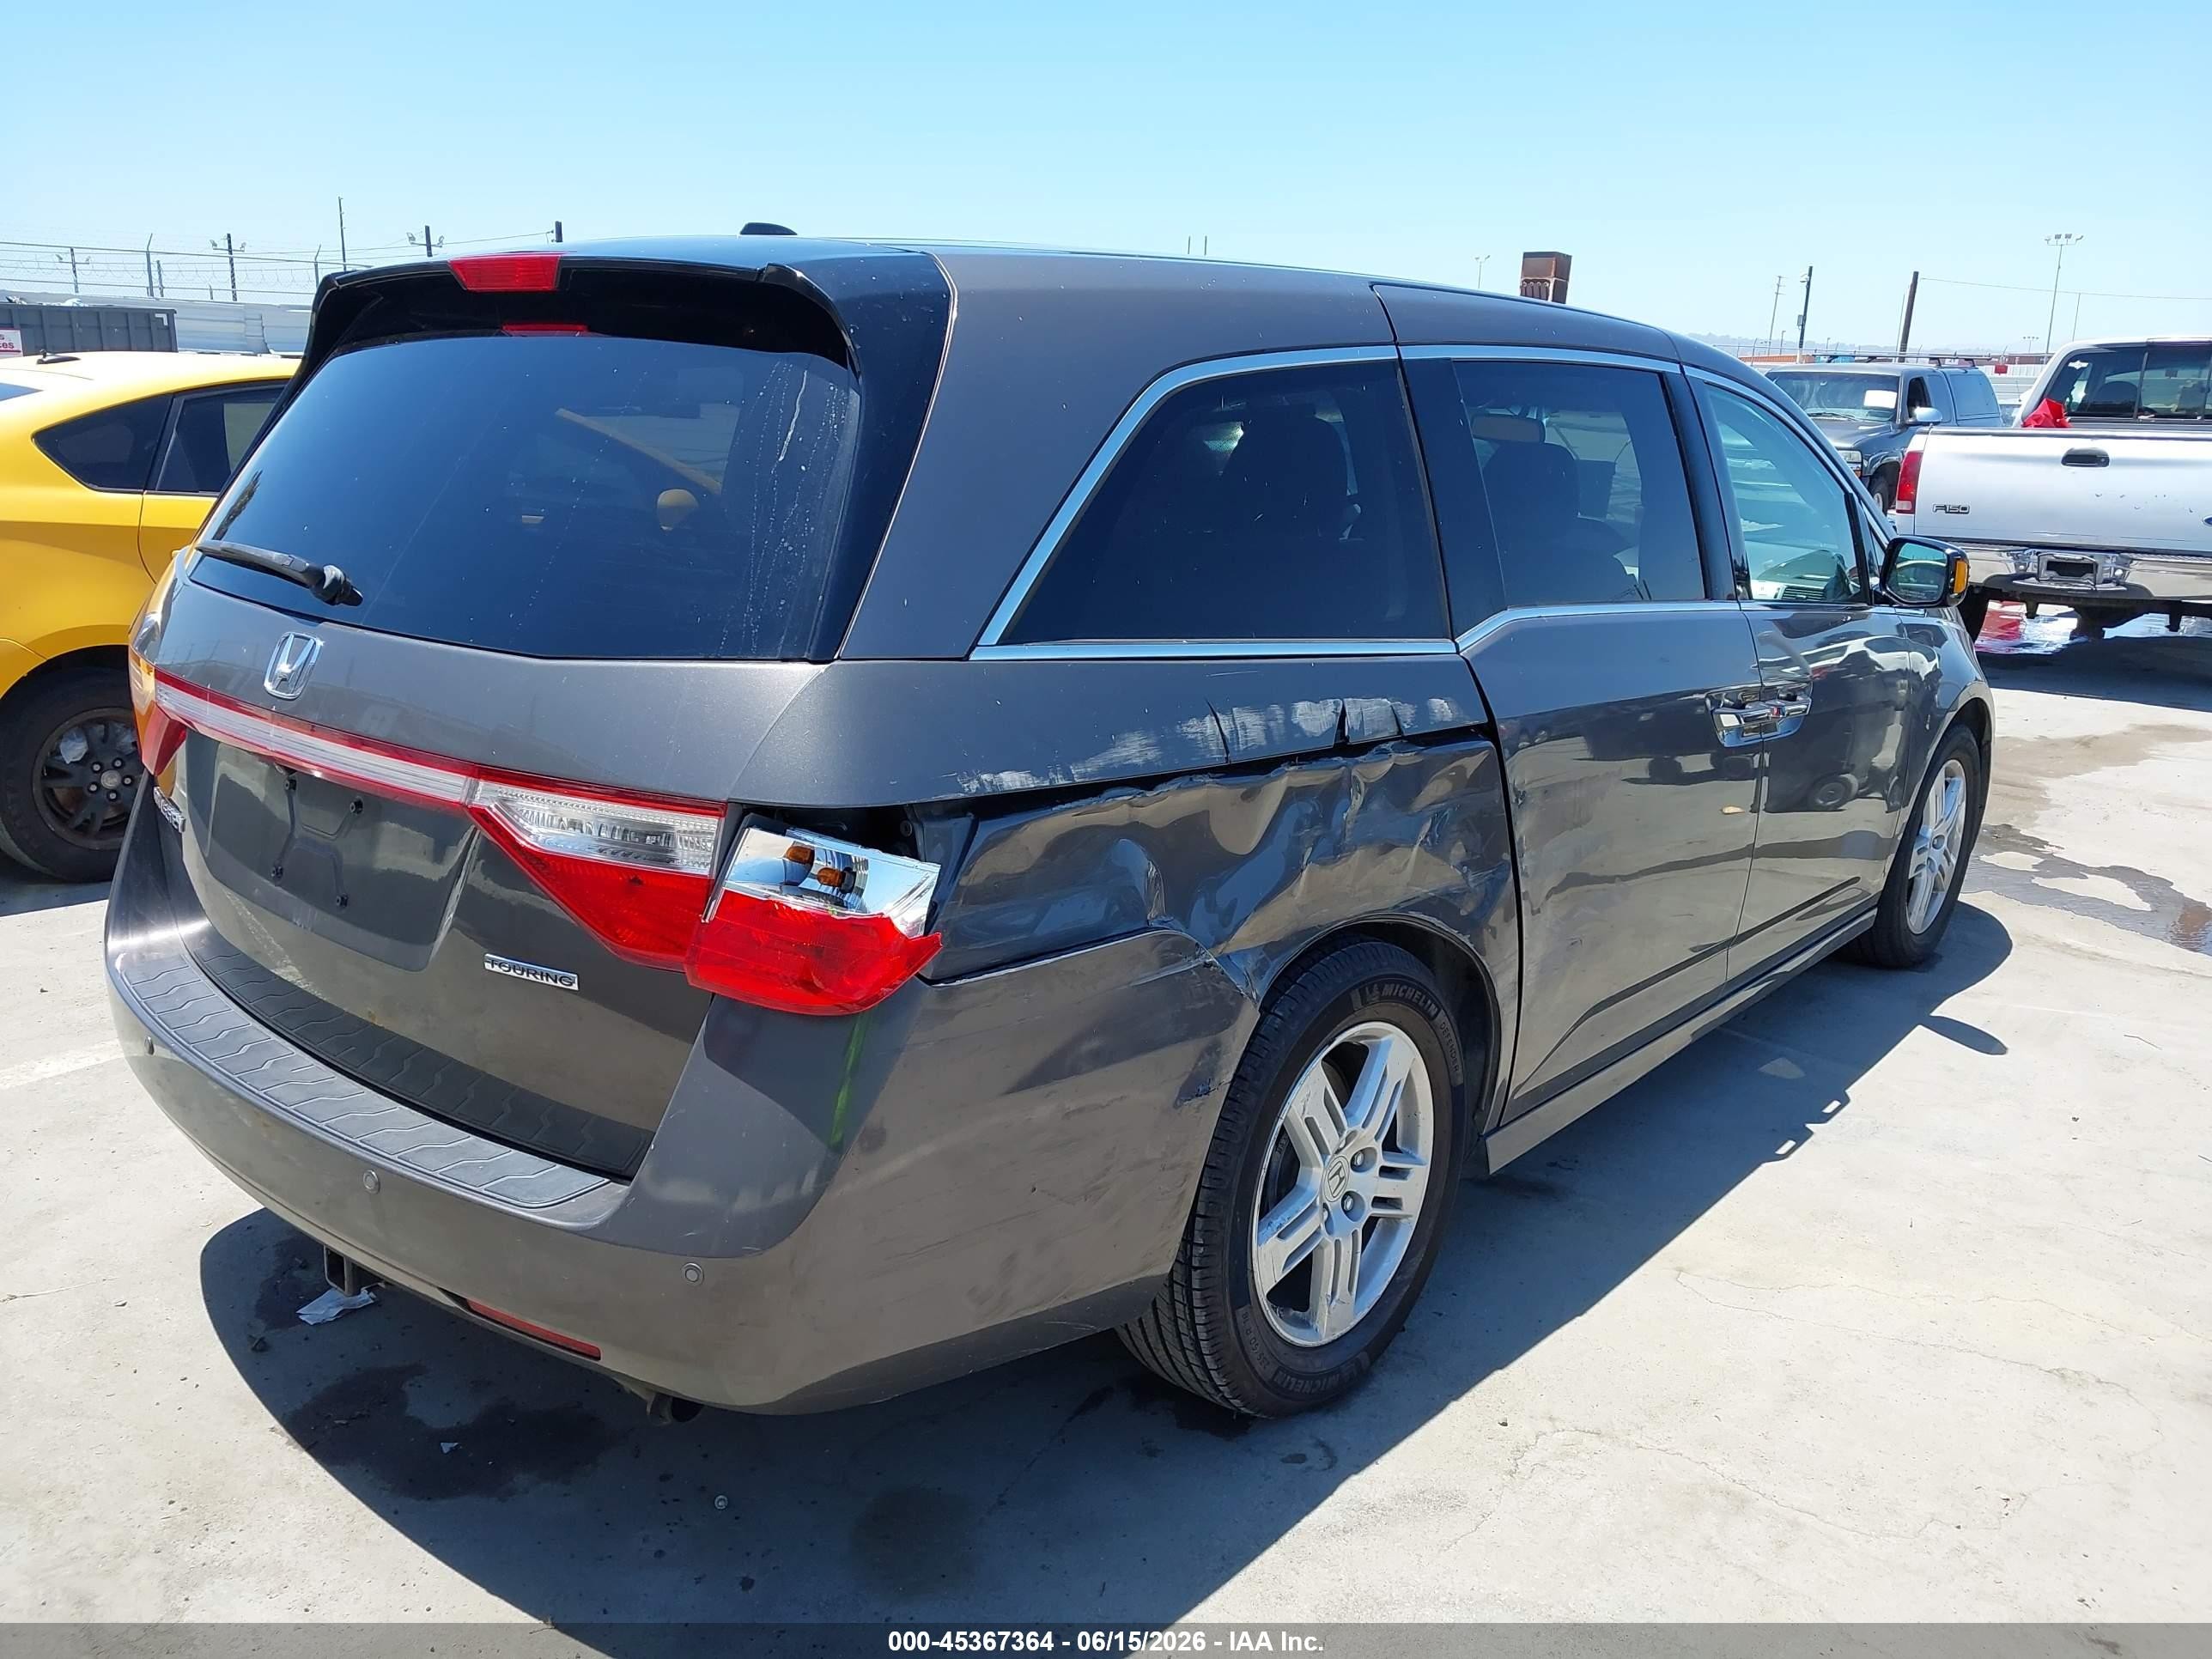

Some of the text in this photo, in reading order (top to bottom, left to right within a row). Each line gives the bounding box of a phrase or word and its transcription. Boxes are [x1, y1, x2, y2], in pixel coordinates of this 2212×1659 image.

[1932, 503, 1971, 514] F150
[484, 959, 576, 987] TOURING
[1382, 982, 1439, 1017] MICHELIN
[1439, 1022, 1460, 1073] DEFENDER
